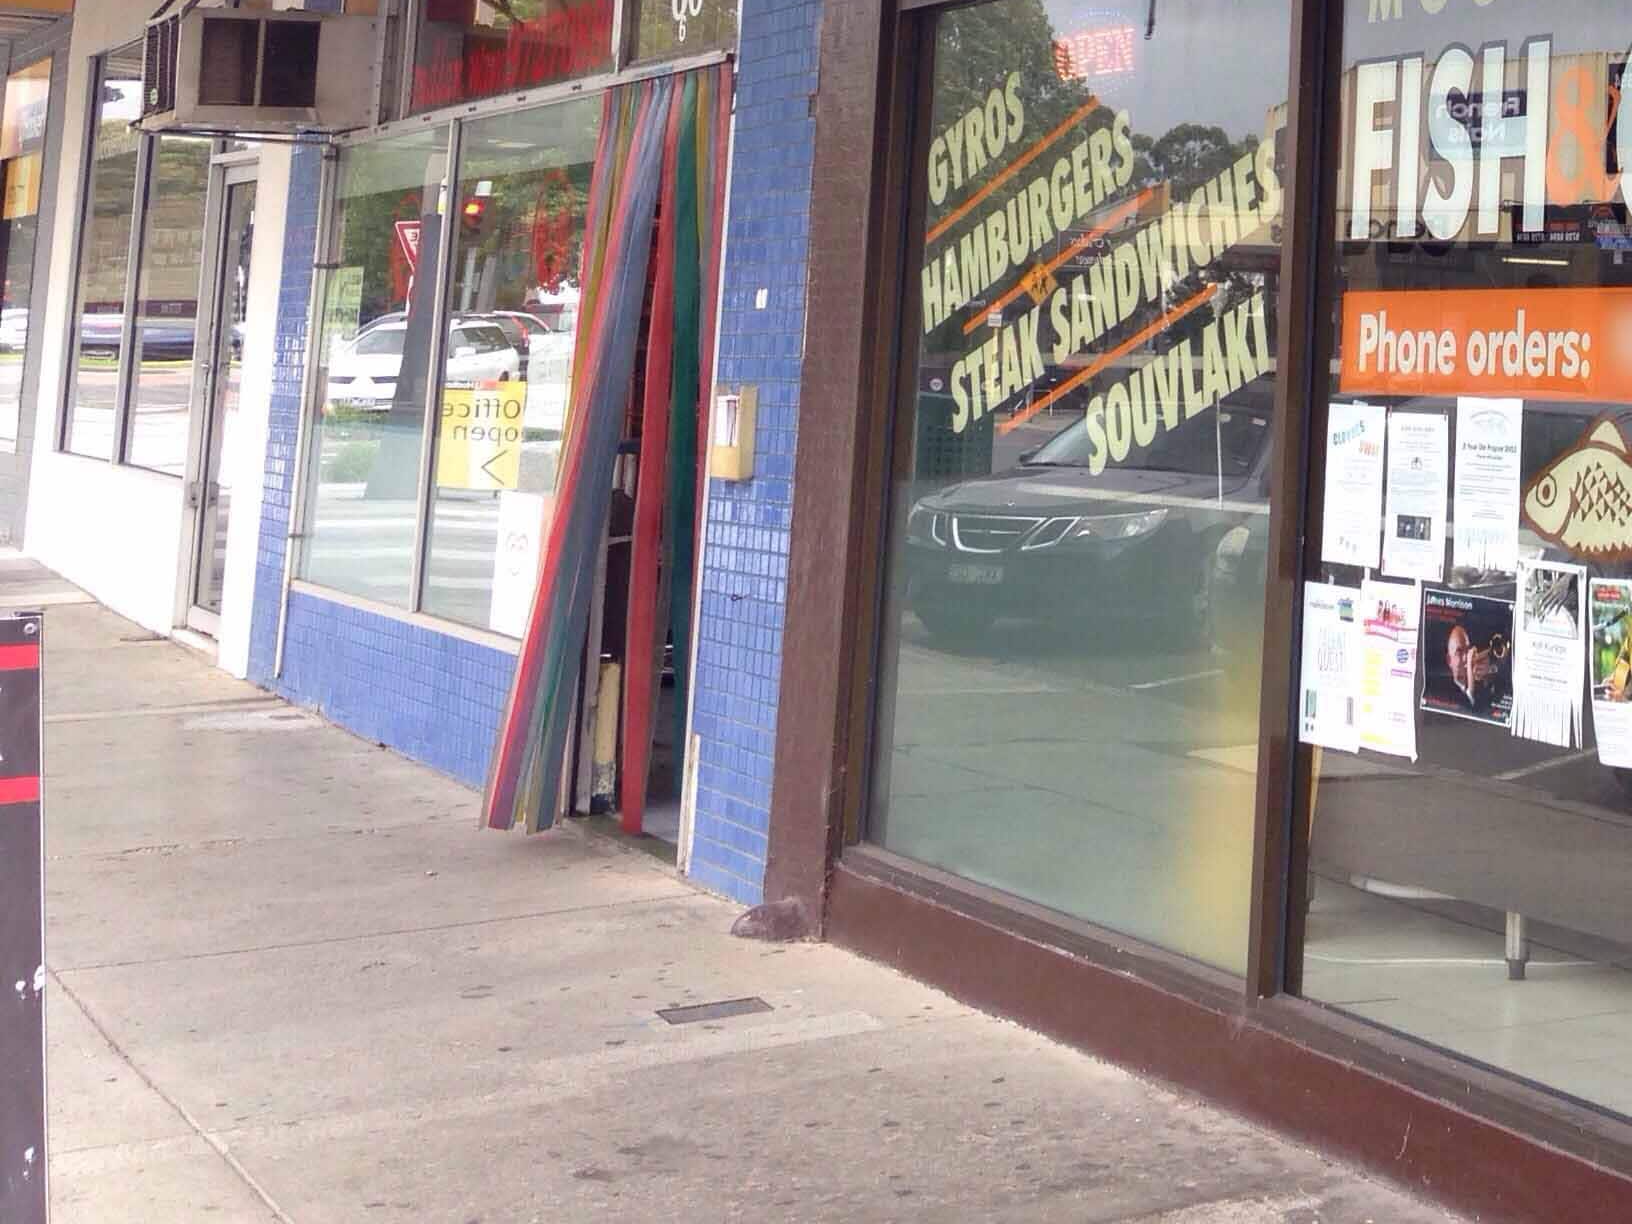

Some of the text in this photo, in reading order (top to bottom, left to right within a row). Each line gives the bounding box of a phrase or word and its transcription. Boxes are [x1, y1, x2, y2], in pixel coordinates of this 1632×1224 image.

[921, 110, 1134, 334] HAMBURGERS
[927, 72, 1025, 206] GYROS
[1350, 40, 1552, 241] FISH
[1546, 65, 1621, 207] &
[951, 138, 1282, 433] STEAK SANDWICHES
[1358, 309, 1456, 375] Phone
[1467, 309, 1591, 378] orders:
[1087, 293, 1271, 476] SOUVLAKI
